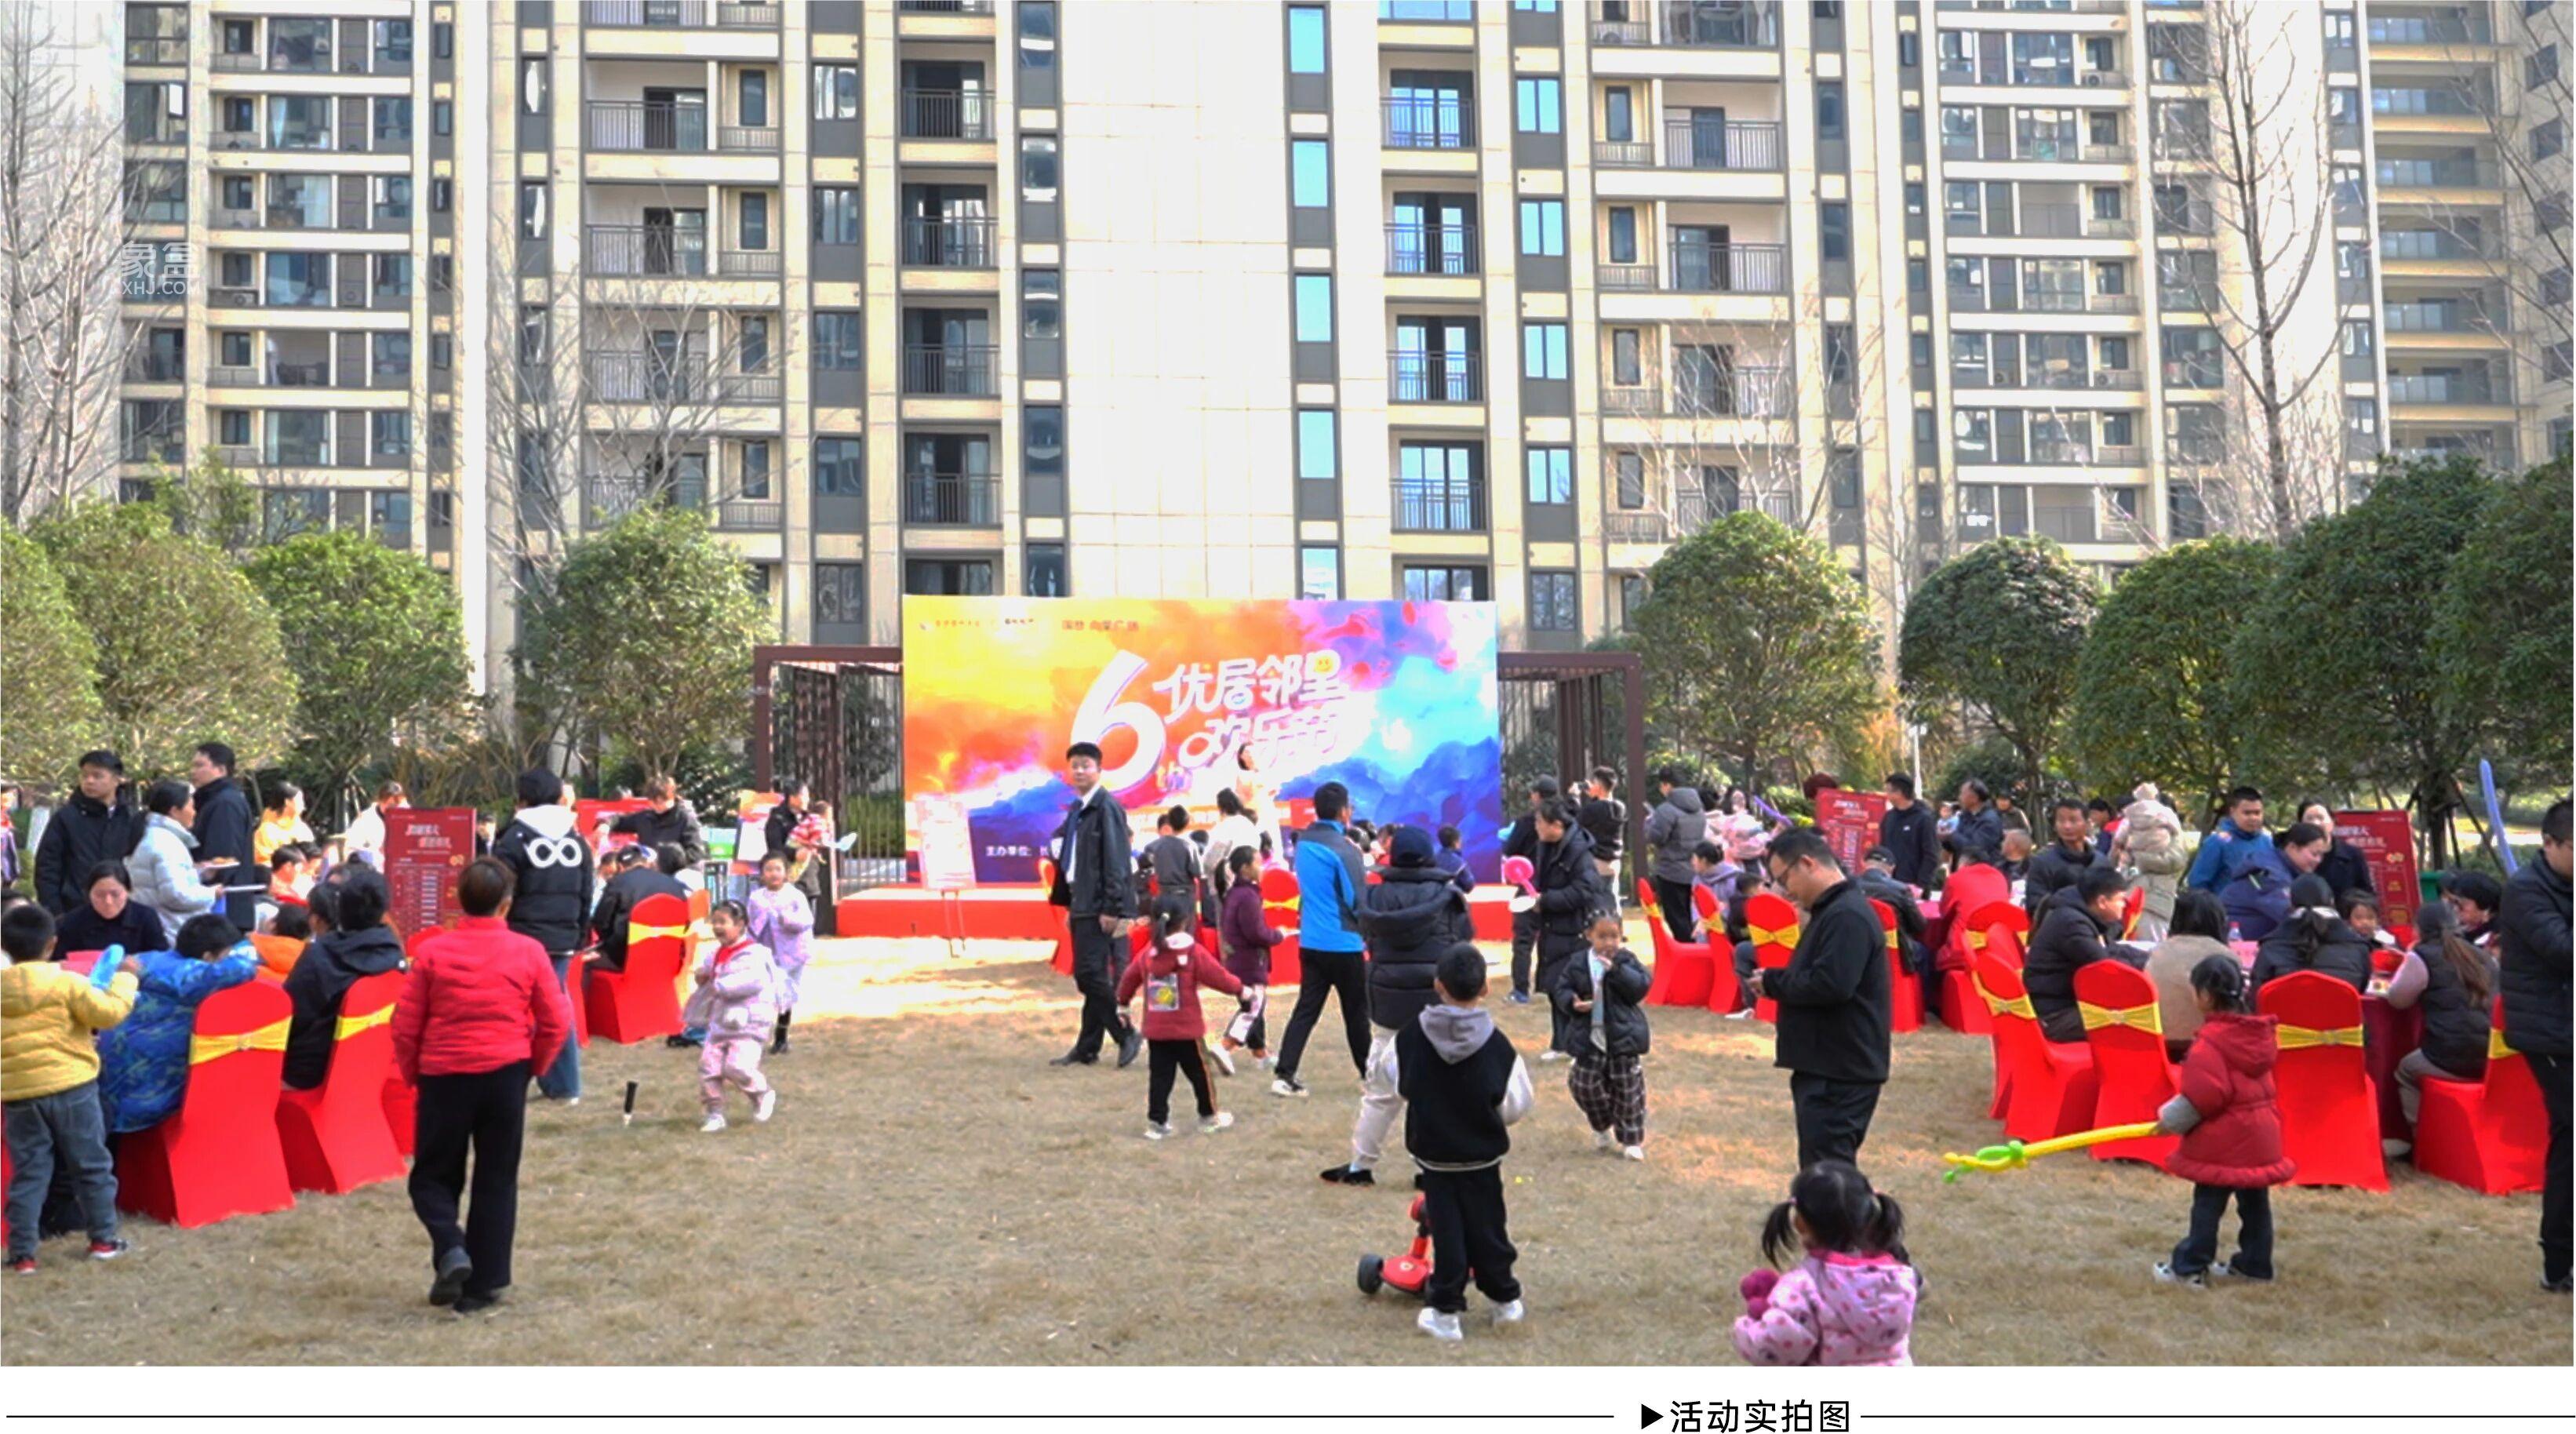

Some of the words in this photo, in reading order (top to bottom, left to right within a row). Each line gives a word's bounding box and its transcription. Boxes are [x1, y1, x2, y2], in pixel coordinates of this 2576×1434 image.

[1070, 650, 1166, 795] 6
[1152, 649, 1350, 725] 优居邻里
